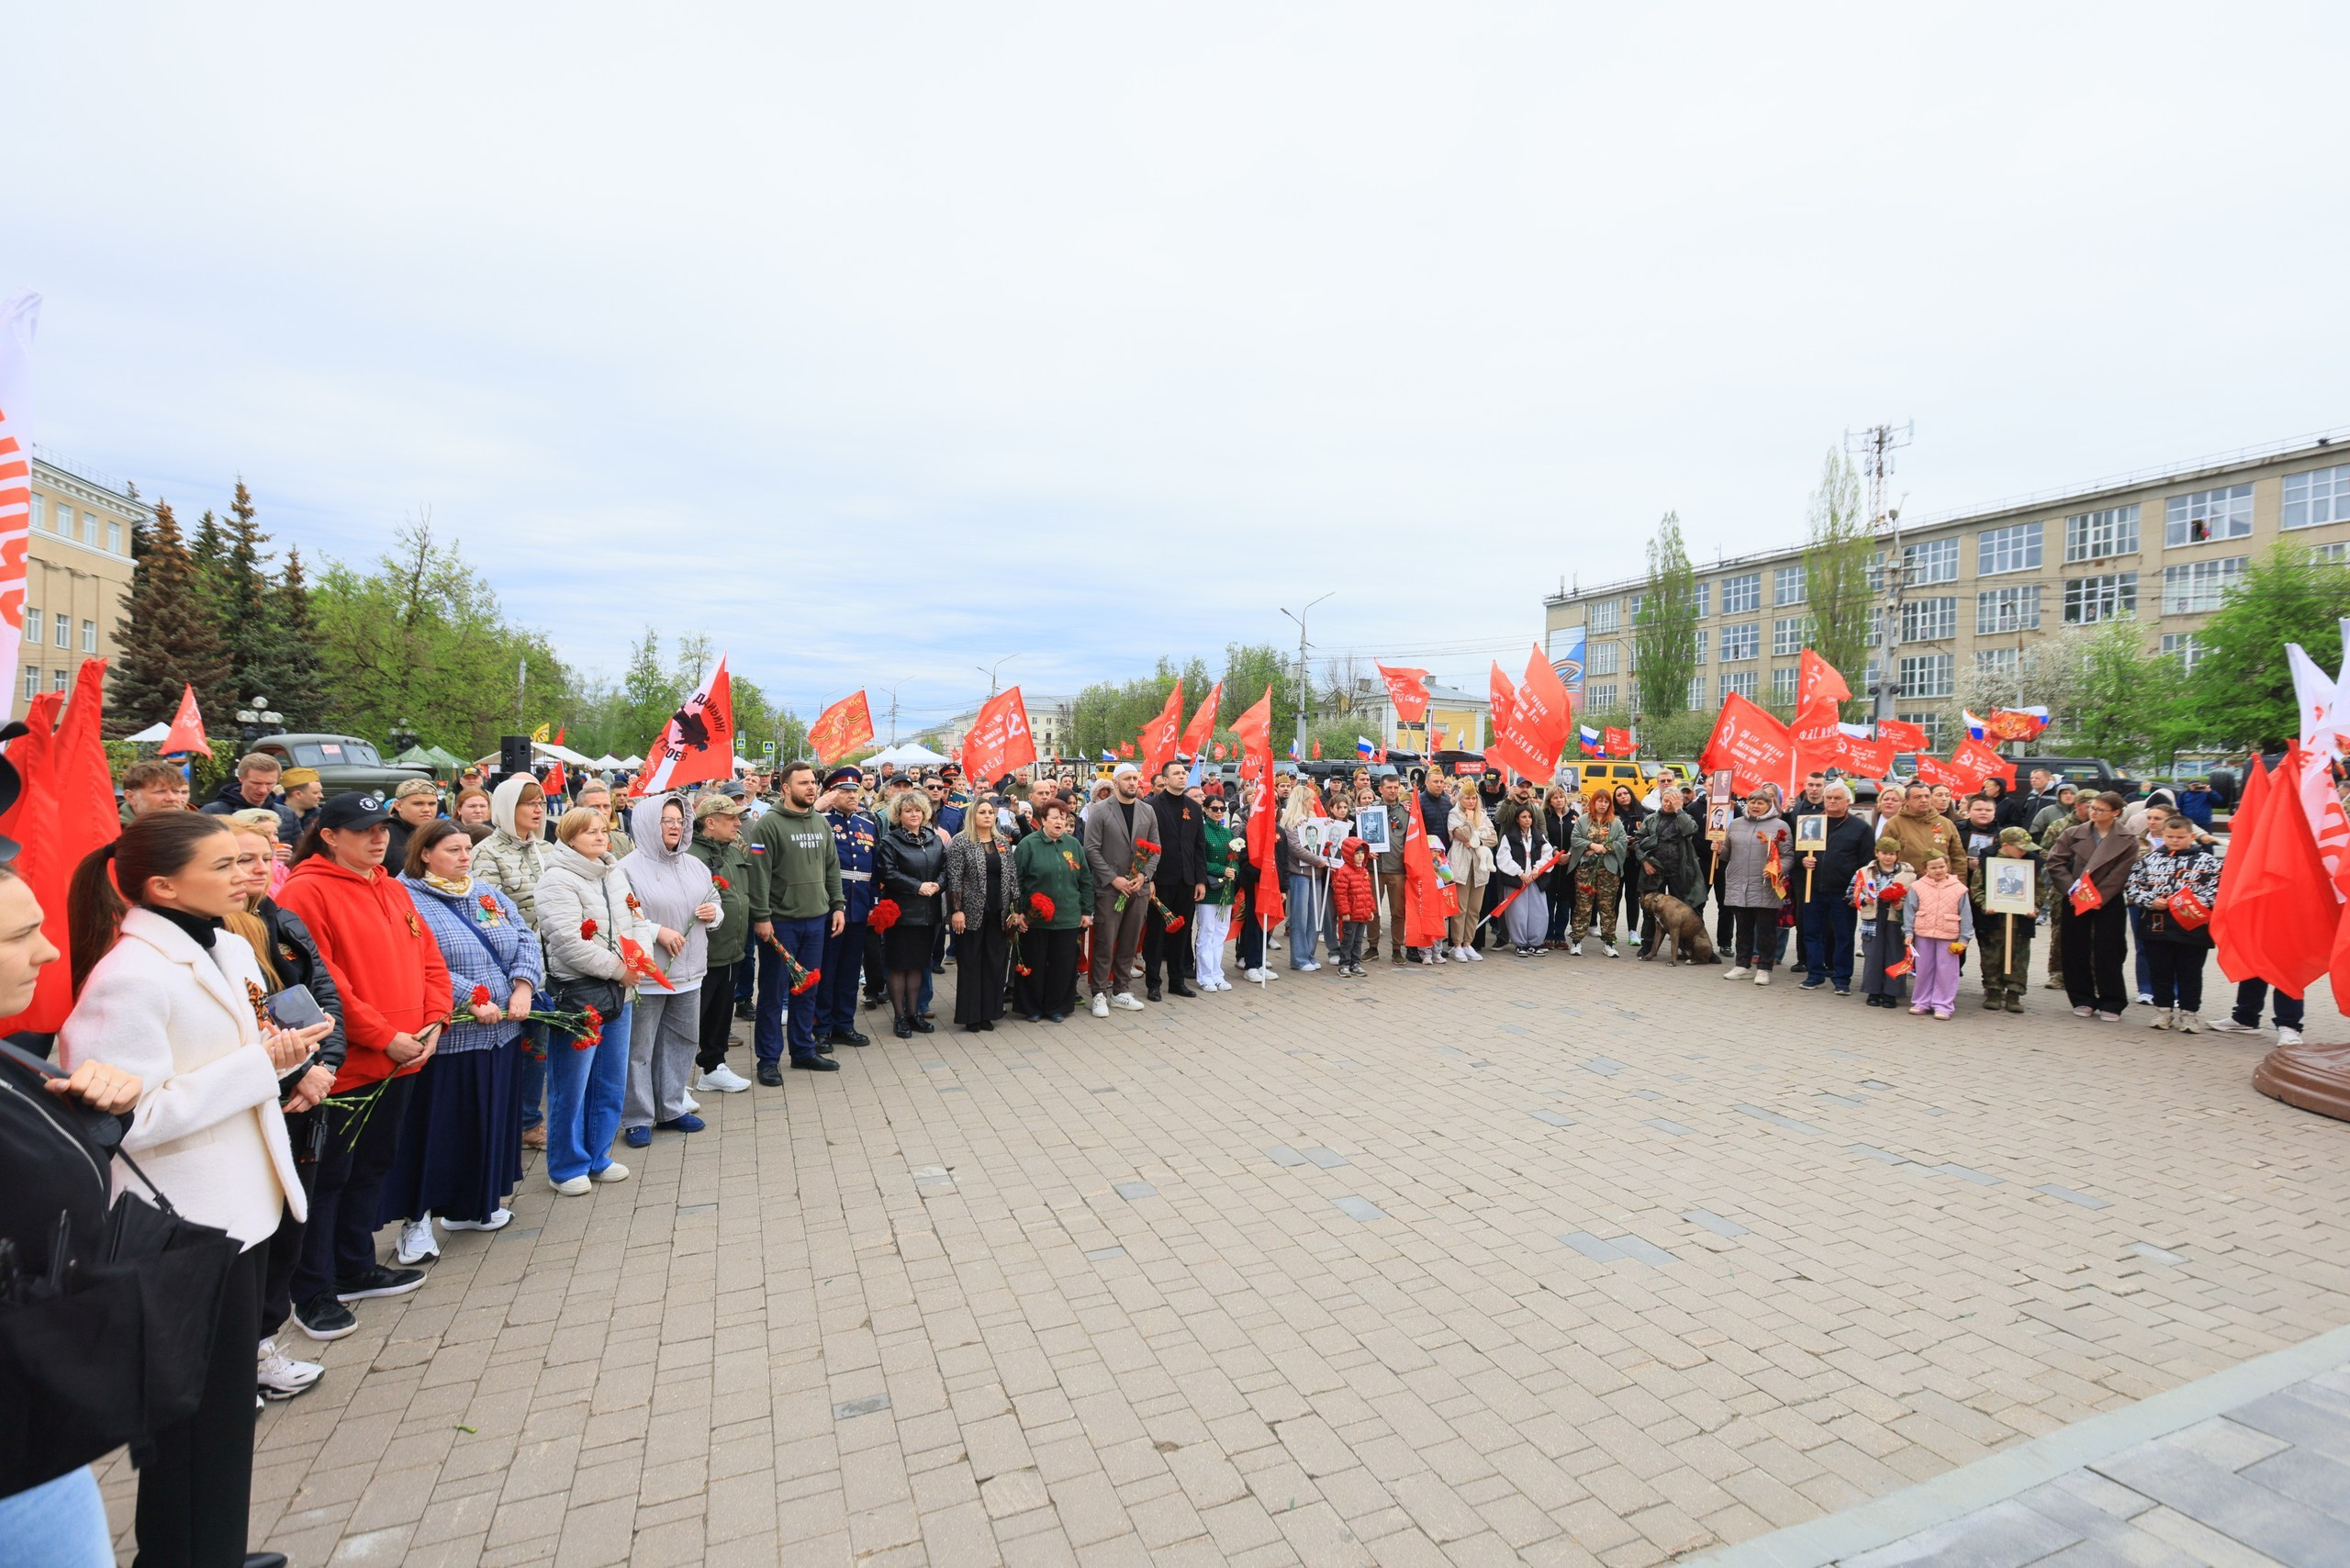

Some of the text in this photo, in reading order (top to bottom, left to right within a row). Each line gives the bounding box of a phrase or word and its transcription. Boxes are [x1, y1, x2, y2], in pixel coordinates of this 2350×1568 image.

[655, 737, 688, 761] ГЕОЕВ
[1733, 760, 1743, 777] 79
[790, 832, 823, 842] НАРОДНЫЙ
[800, 840, 819, 849] ФРОНТ
